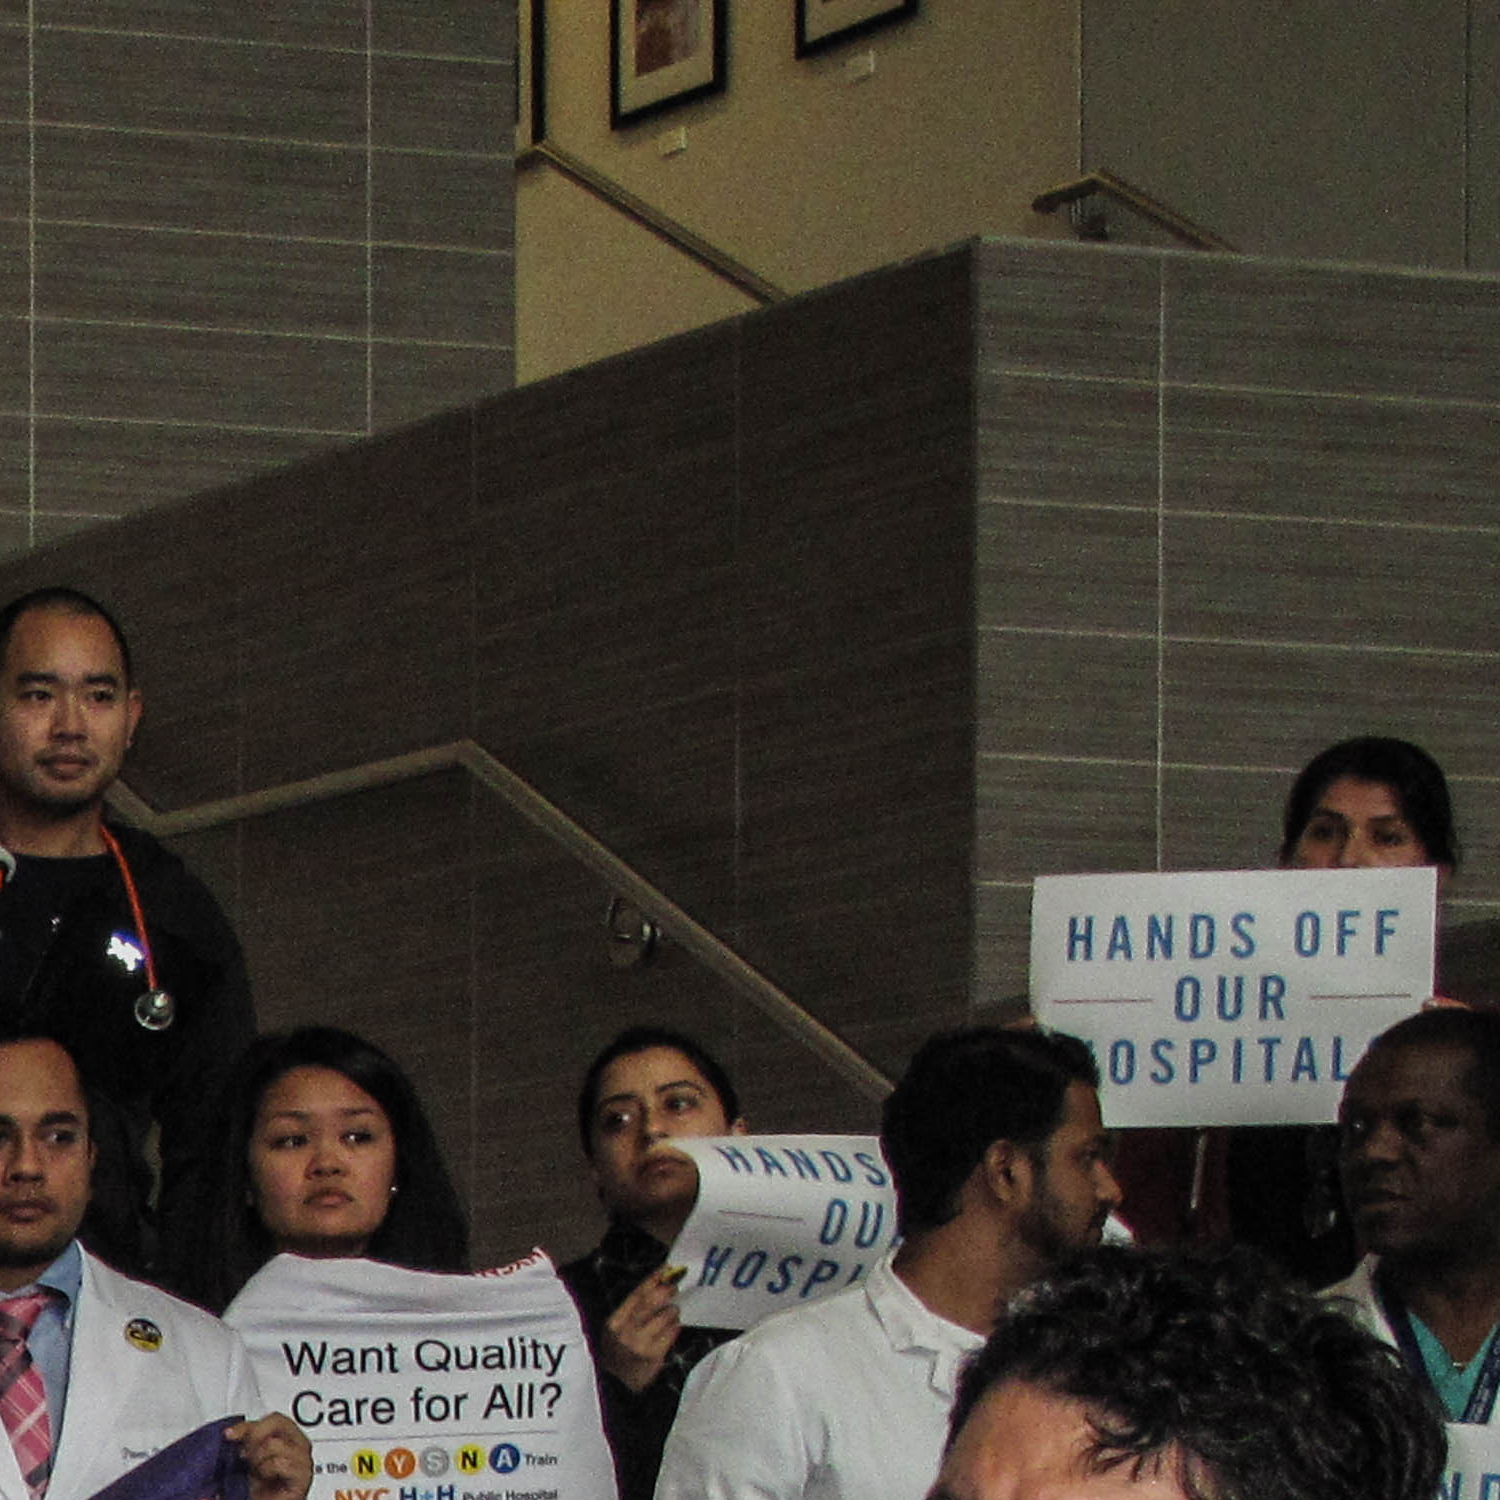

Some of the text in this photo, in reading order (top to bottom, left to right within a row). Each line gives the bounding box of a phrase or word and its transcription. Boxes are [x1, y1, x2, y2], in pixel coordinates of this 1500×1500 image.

[1067, 909, 1401, 961] HANDS OFF
[1174, 974, 1287, 1023] OUR
[1086, 1035, 1380, 1086] OSPITAL
[714, 1146, 887, 1188] HANDS
[820, 1198, 884, 1250] OU
[697, 1245, 863, 1298] HOSPI
[283, 1337, 567, 1378] Want Quality
[292, 1382, 563, 1428] Care for All?
[327, 1463, 347, 1474] the
[525, 1453, 558, 1466] Train
